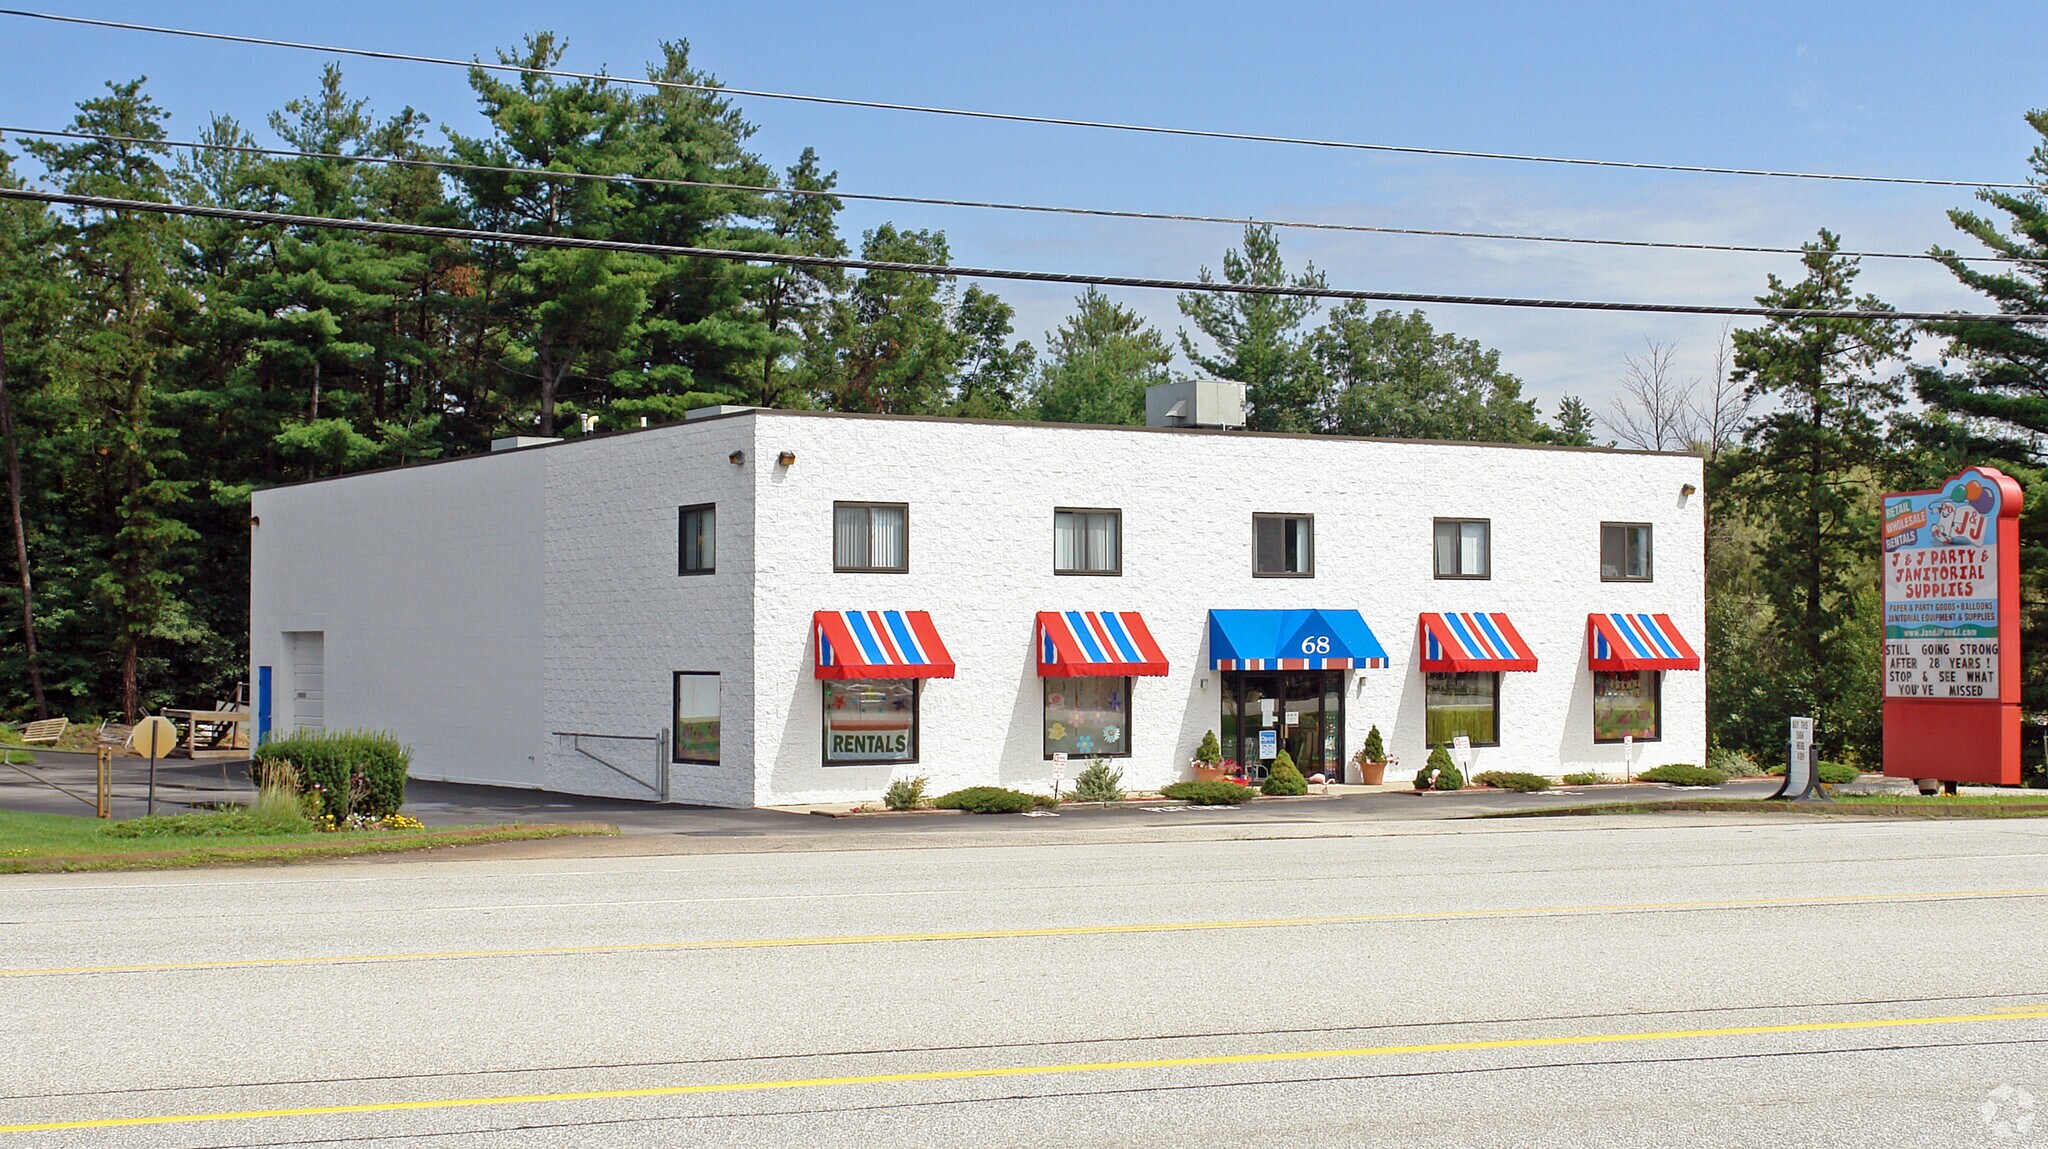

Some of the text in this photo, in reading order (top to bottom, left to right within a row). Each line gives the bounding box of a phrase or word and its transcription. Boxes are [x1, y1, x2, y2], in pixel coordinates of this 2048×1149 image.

[1886, 501, 1910, 519] RETAIL
[1886, 510, 1926, 533] WHOLESALE
[1886, 531, 1916, 549] RENTALS
[1892, 549, 1989, 567] J & J PARTY &
[1896, 565, 1985, 583] JANITORIAL
[1906, 582, 1973, 599] SUPPLIES
[1890, 604, 1907, 612] PAPER
[1915, 603, 1934, 611] PARTY
[1936, 603, 1956, 611] GOODS
[1961, 602, 1993, 610] BALLOONS
[1888, 612, 1995, 623] JANITORIAL EQUIPMENT & SUPPLIES
[1301, 635, 1331, 655] 68
[1886, 644, 1998, 655] STILL GOING STRONG
[1890, 658, 1917, 669] AFTER
[1929, 658, 1940, 669] 28
[1890, 671, 1994, 683] STOP & SEE WHAT
[1899, 684, 1983, 697] YOU'VE MISSED
[833, 734, 906, 753] RENTALS
